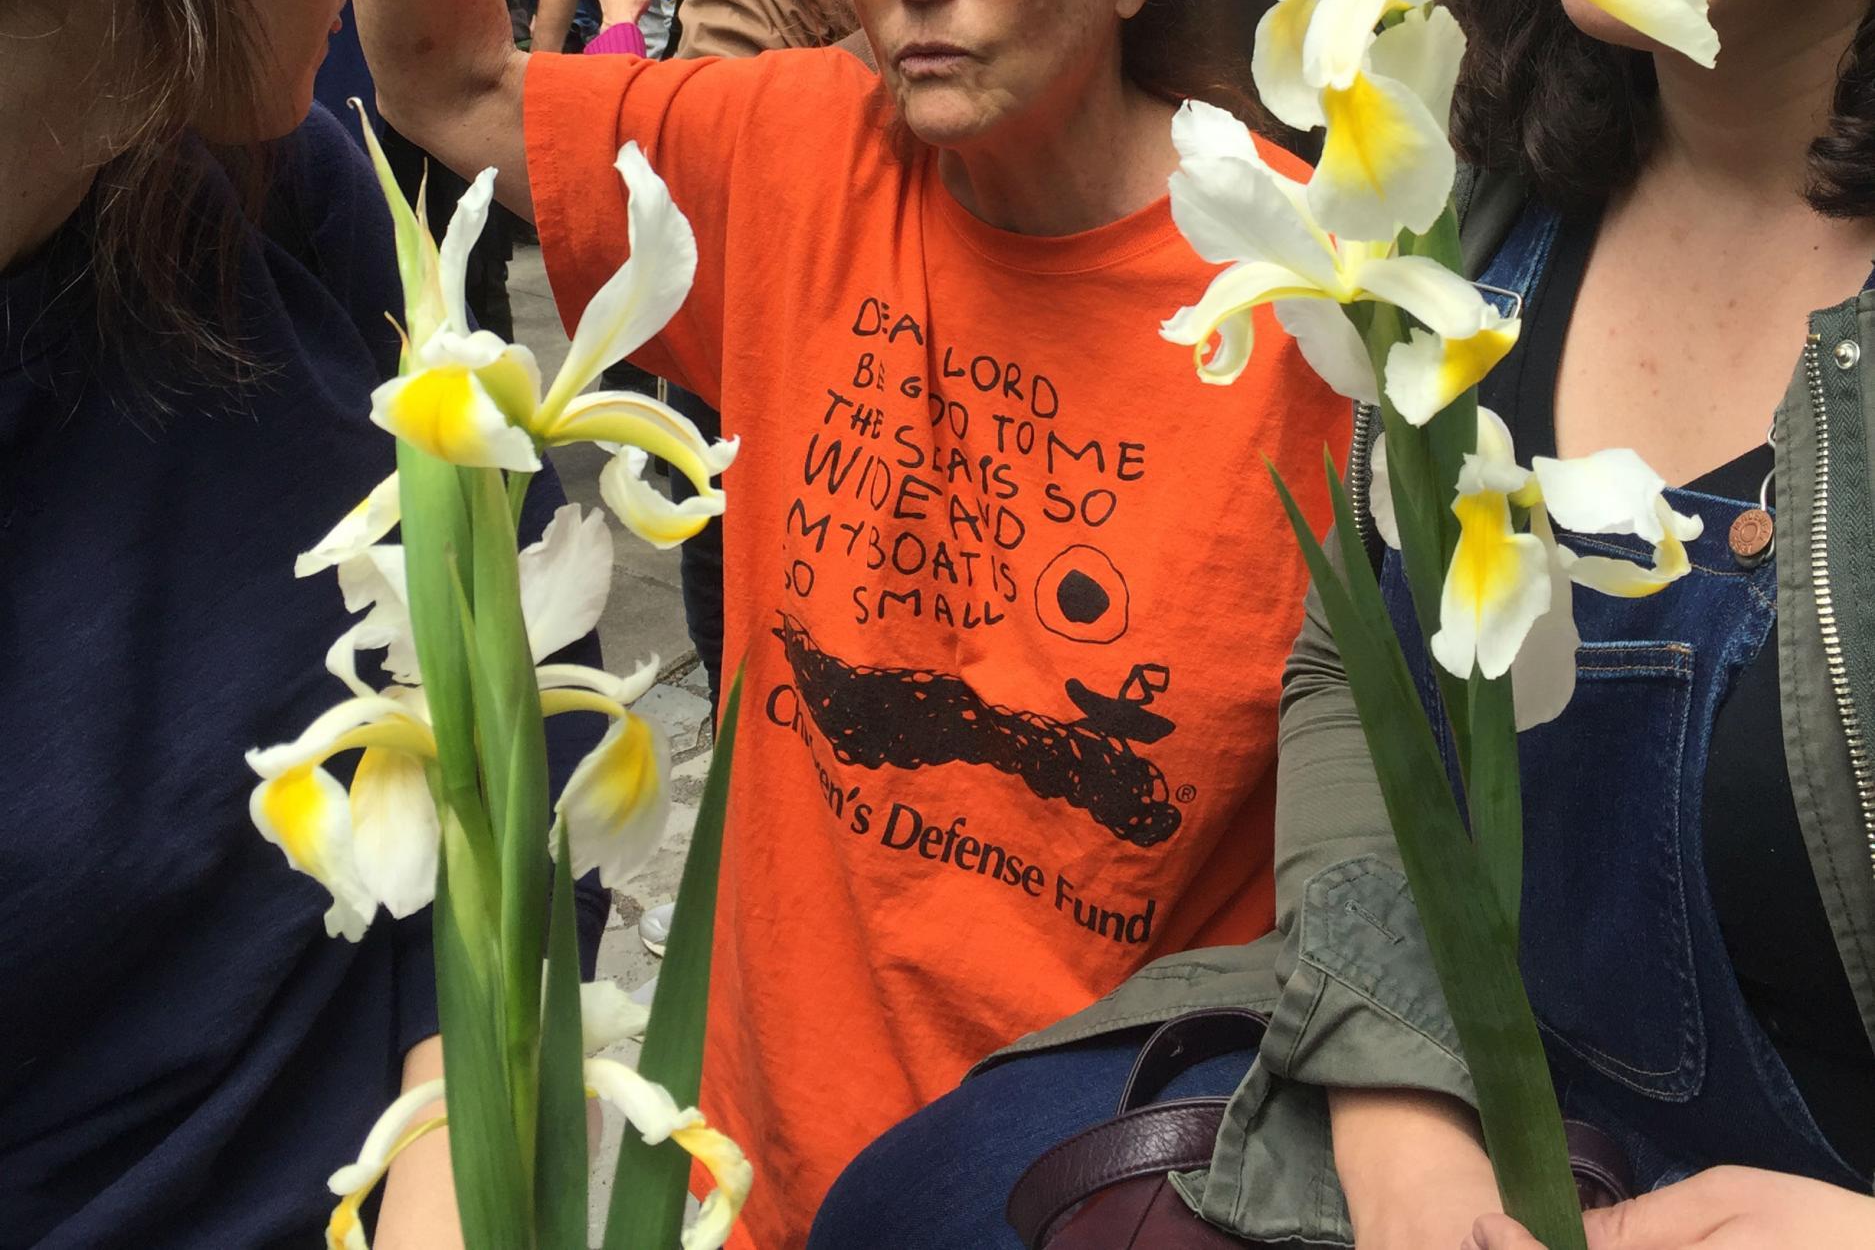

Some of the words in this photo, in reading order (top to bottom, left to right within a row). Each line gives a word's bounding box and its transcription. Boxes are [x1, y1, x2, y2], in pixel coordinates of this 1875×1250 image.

[944, 347, 1059, 419] LORD
[804, 433, 942, 520] WIDE
[950, 494, 1026, 550] AND
[825, 389, 884, 440] THE
[1043, 483, 1117, 527] SO
[992, 413, 1035, 455] TO
[1047, 431, 1146, 480] ME
[785, 497, 865, 556] MY
[867, 532, 981, 587] BOAT
[992, 555, 1017, 602] IS
[853, 585, 1005, 629] SMALL
[880, 802, 1045, 898] Defense
[1055, 874, 1157, 945] Fund
